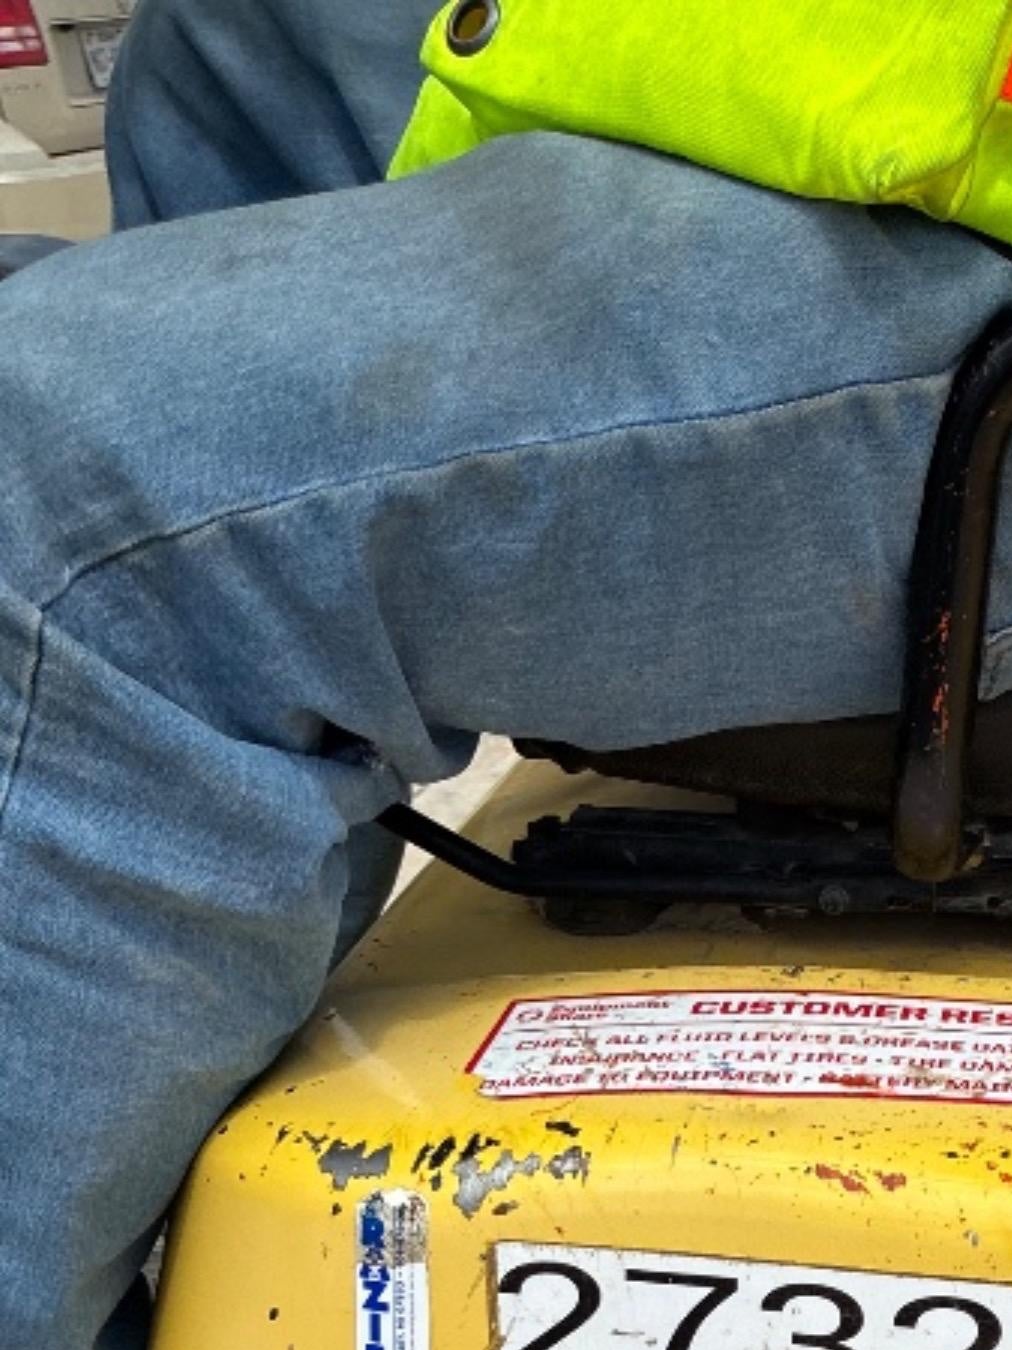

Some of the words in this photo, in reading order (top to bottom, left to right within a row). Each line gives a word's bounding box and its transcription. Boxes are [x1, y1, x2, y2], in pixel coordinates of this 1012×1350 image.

[690, 1001, 927, 1020] CUSTOMER
[515, 1035, 597, 1051] CHECK
[606, 1034, 648, 1046] ALL
[656, 1031, 732, 1043] FLUID
[739, 1031, 832, 1045] LEVELS
[721, 1050, 778, 1062] FLAT
[479, 1072, 589, 1090] DAMAGE
